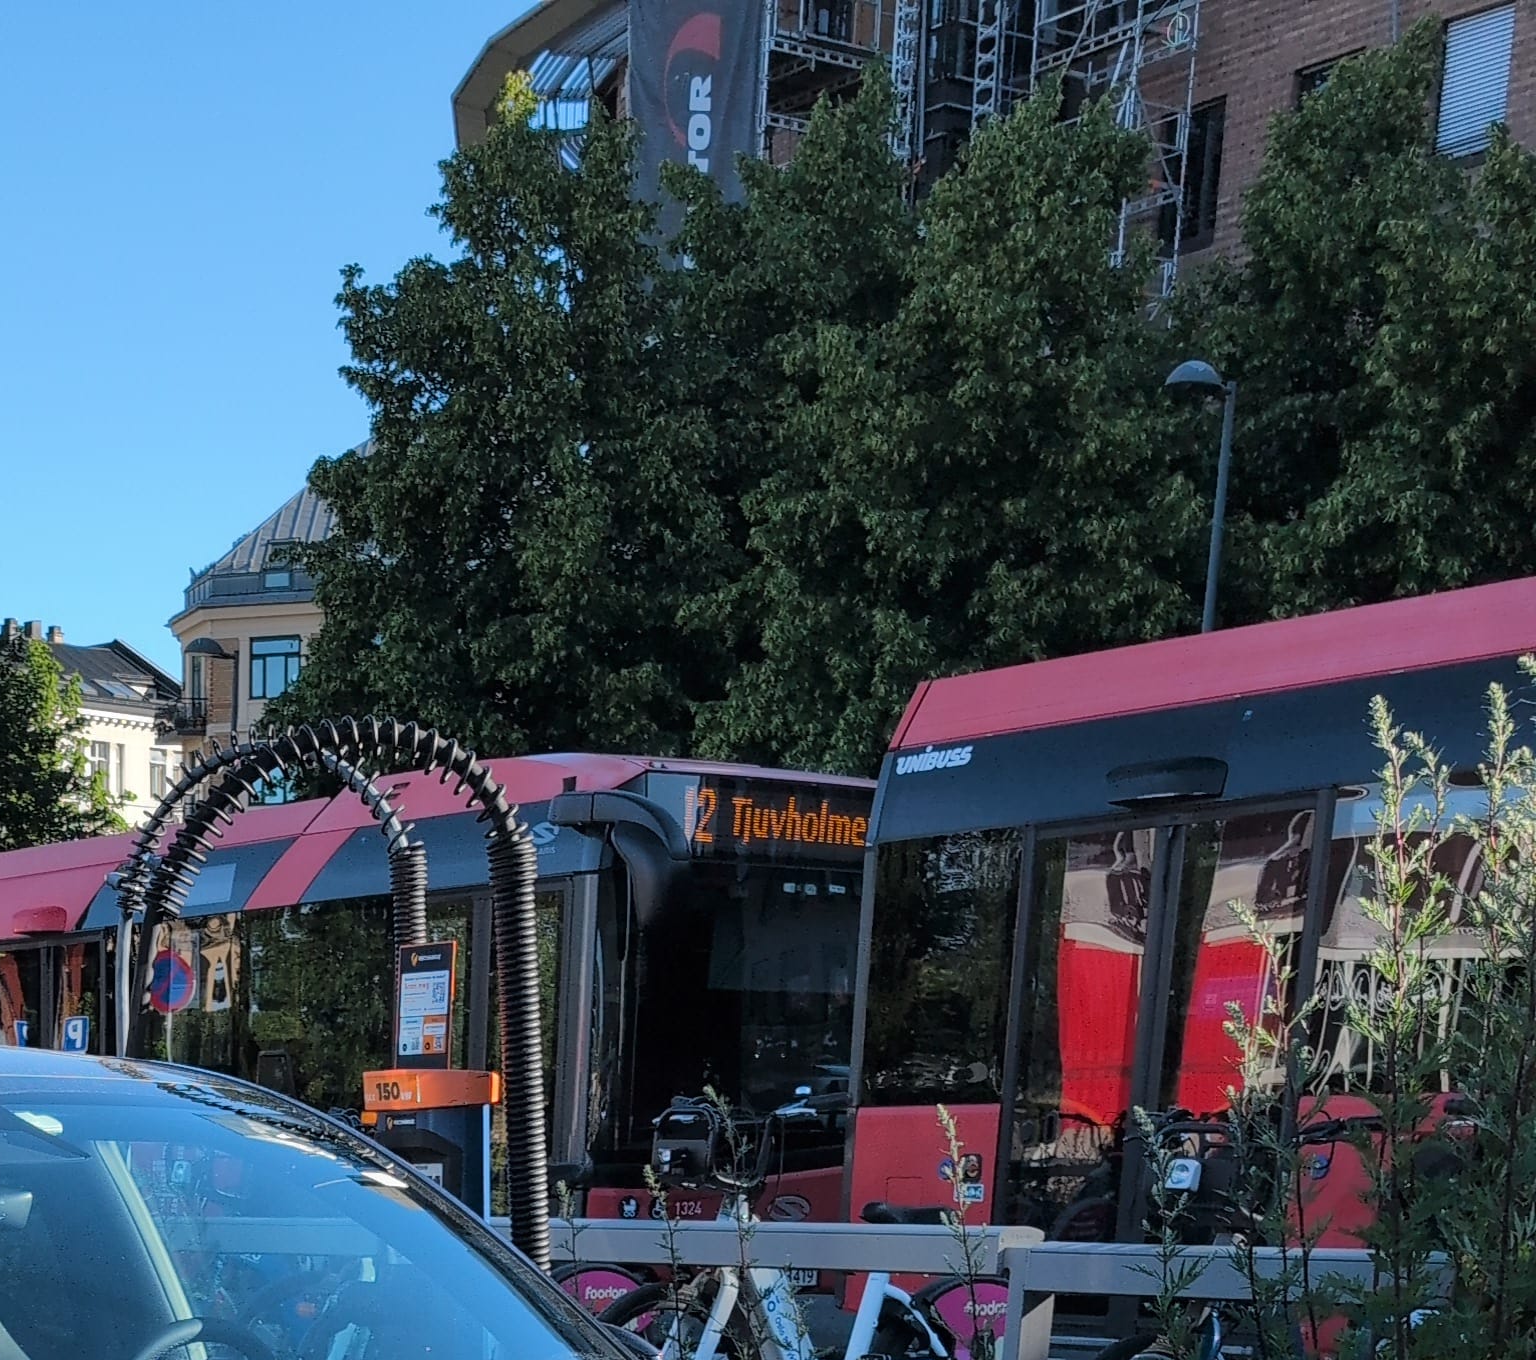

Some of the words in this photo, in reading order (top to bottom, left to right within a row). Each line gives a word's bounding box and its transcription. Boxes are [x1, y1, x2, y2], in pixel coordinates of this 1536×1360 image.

[731, 796, 867, 847] Tjuvholme
[375, 1081, 401, 1101] 150
[674, 1201, 702, 1216] 1324
